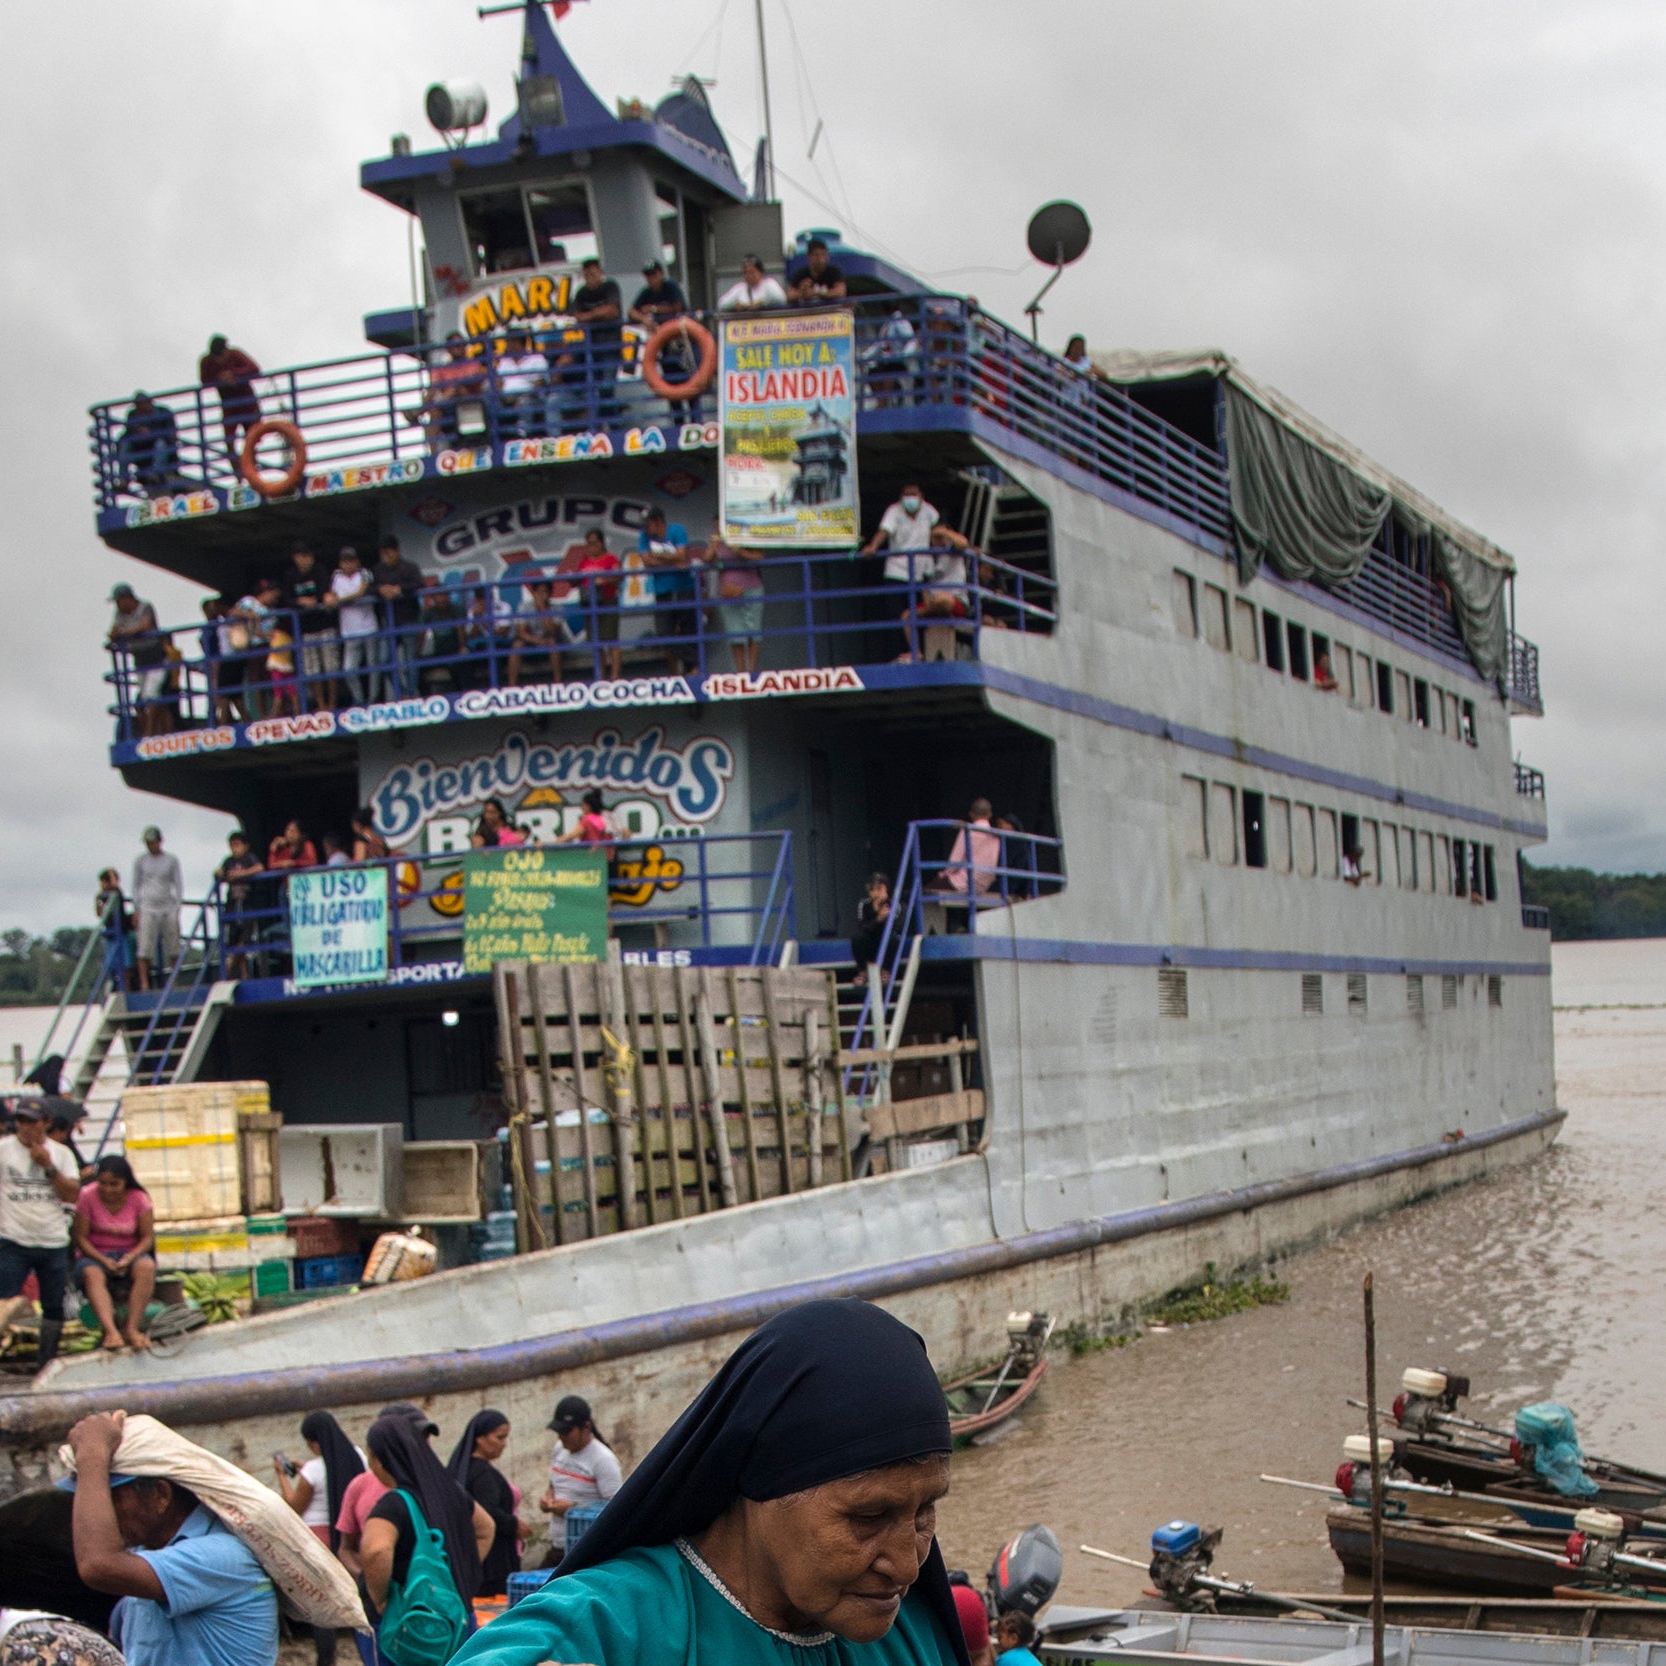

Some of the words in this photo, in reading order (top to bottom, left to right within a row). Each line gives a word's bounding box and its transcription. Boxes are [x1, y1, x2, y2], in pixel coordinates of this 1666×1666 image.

[735, 346, 773, 369] SALE
[778, 344, 814, 366] HOY
[728, 368, 847, 401] ISLANDIA
[309, 461, 423, 493] MAESTRO
[440, 451, 491, 473] QUE
[506, 435, 611, 462] ENSEÑA
[627, 428, 664, 451] LA
[144, 731, 234, 757] IQUITOS
[254, 715, 332, 740] PEVAS
[465, 682, 585, 713] CABALLO
[593, 677, 688, 701] COCHA
[711, 669, 857, 695] ISLANDIA
[503, 850, 545, 871] OJO
[320, 870, 367, 898] USO
[321, 929, 343, 946] DE
[295, 948, 384, 979] MASCARILLA
